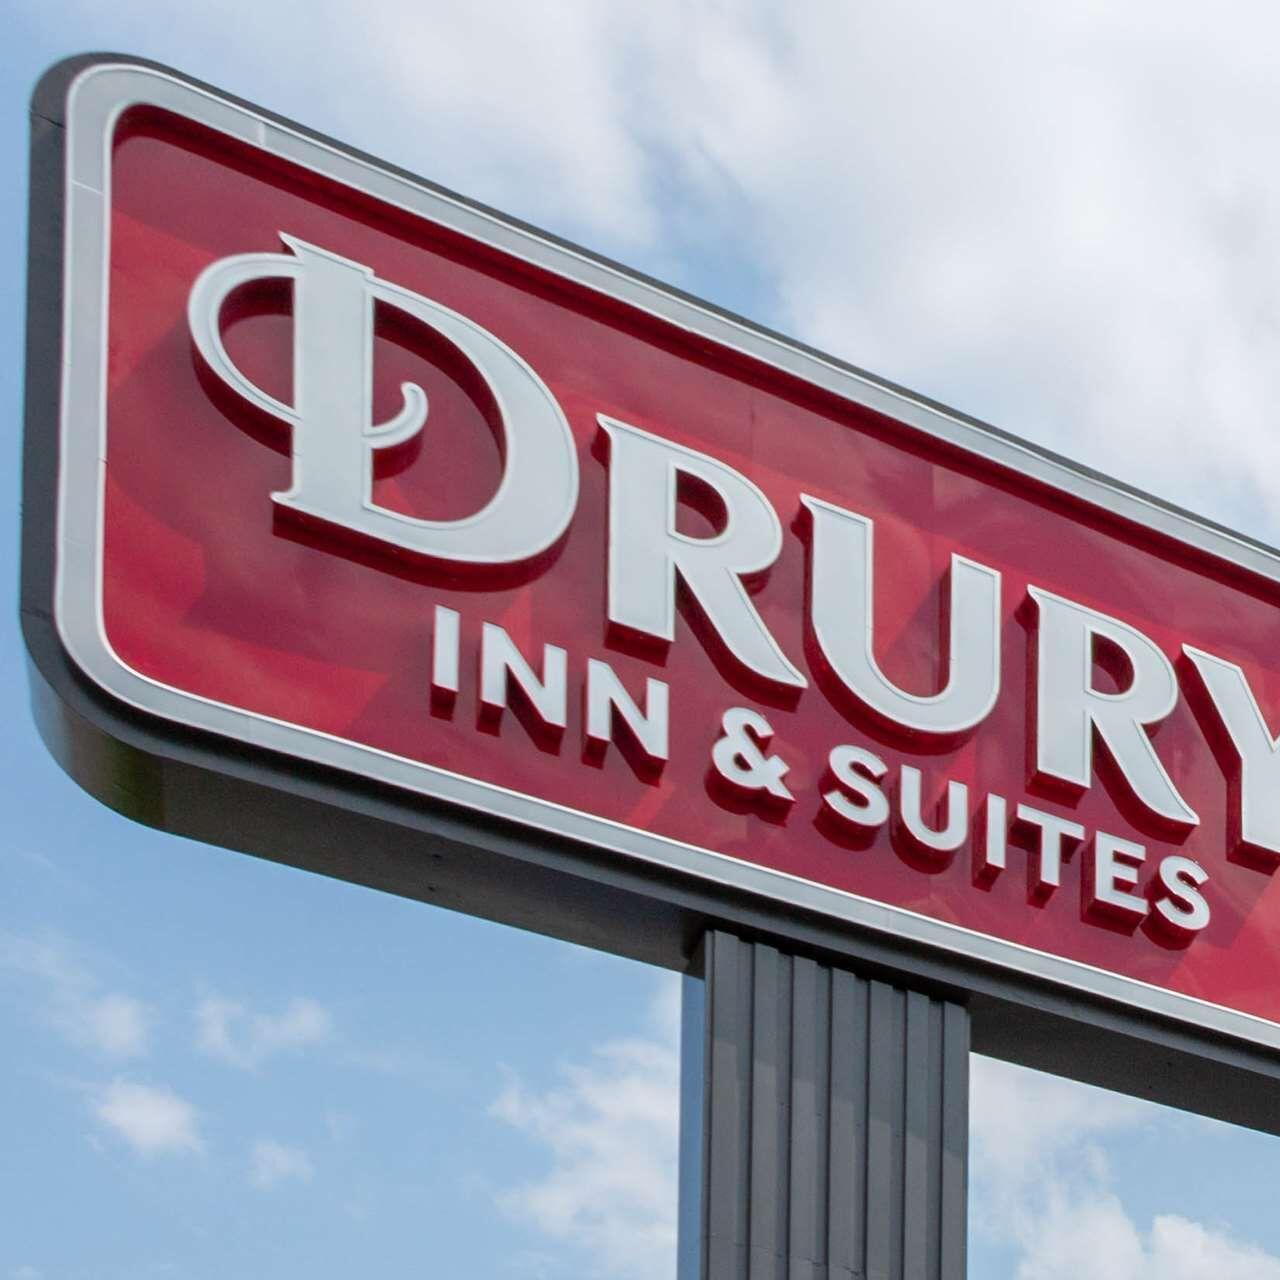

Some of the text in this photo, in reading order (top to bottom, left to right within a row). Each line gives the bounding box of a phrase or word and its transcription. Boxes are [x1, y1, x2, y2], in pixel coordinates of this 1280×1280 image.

[432, 604, 1211, 932] INN & SUITES
